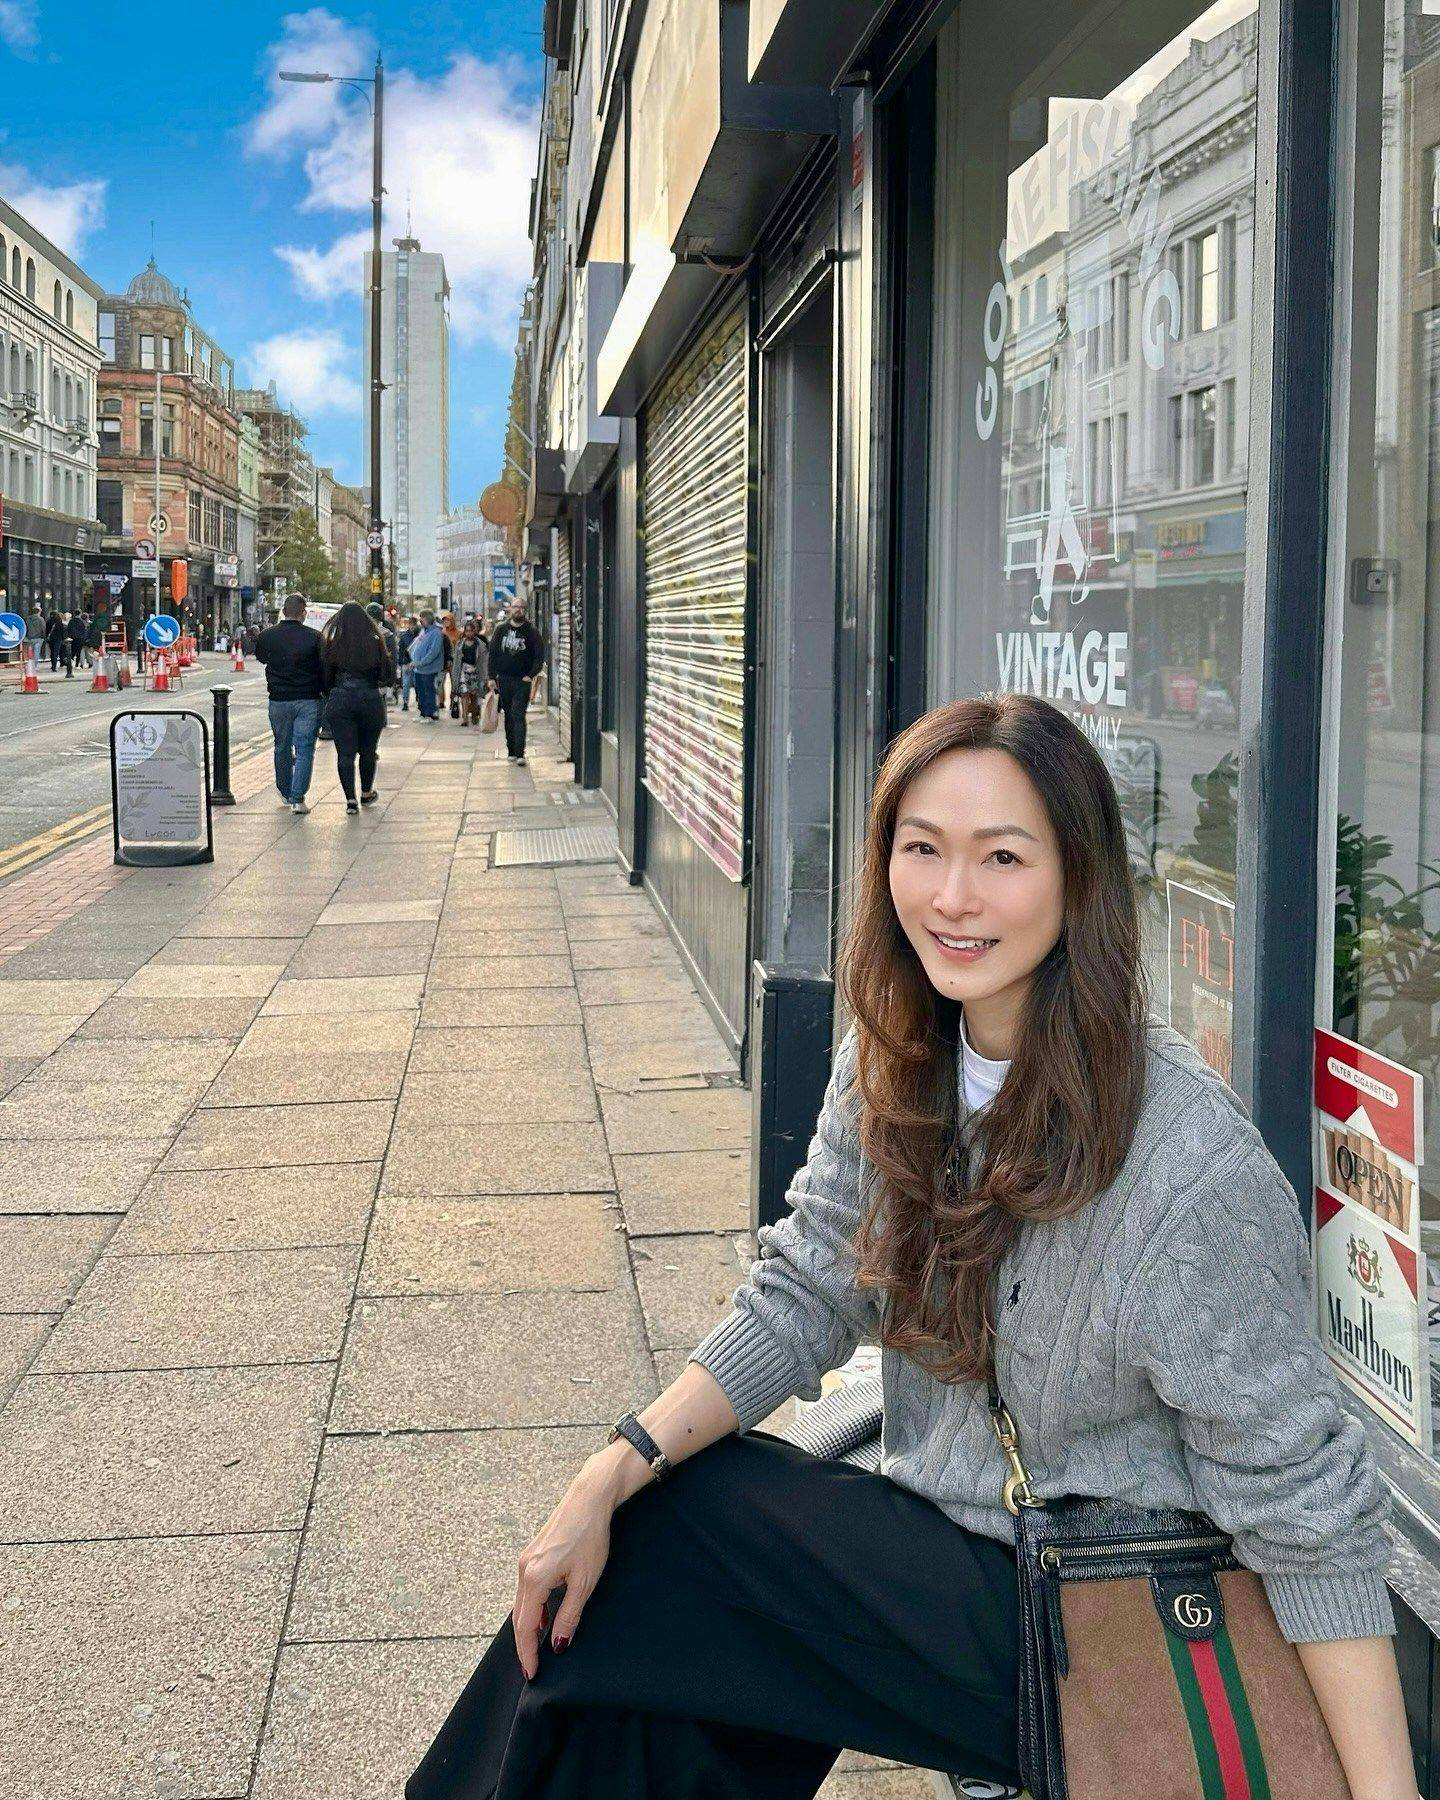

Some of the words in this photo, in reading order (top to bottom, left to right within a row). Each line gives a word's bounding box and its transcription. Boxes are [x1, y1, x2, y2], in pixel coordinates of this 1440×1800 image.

[368, 536, 382, 545] 20
[996, 630, 1127, 706] VINTAGE
[1072, 711, 1122, 750] AMILY
[1331, 1061, 1352, 1080] FILTER
[1353, 1073, 1394, 1102] CIGARETTES
[1336, 1145, 1405, 1222] OPEN
[1327, 1289, 1413, 1403] Marlboro
